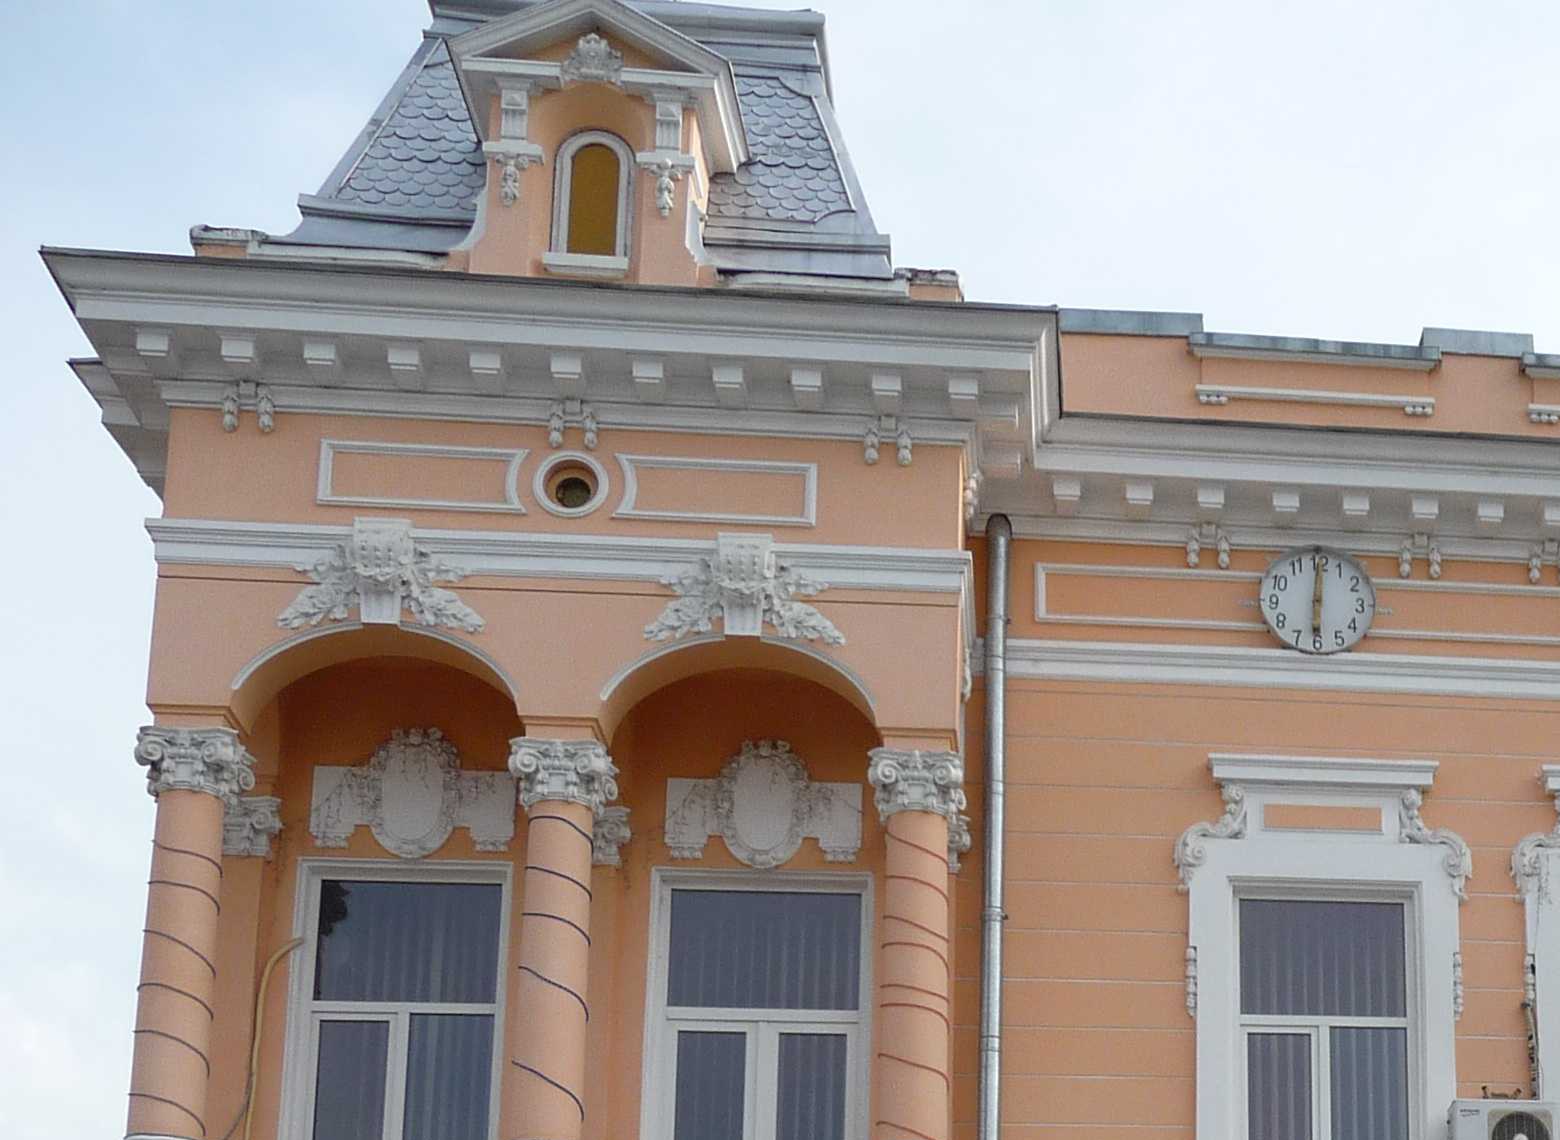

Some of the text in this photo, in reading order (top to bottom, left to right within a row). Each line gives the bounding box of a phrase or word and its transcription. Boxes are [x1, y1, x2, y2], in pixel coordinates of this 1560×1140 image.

[1289, 557, 1302, 576] 11
[1310, 556, 1328, 572] 12
[1336, 563, 1342, 579] 1
[1272, 574, 1287, 591] 10
[1350, 576, 1360, 592] 2
[1269, 594, 1279, 610] 9
[1355, 598, 1364, 614] 3
[1276, 613, 1286, 629] 8
[1347, 617, 1357, 633] 4
[1292, 630, 1302, 645] 7
[1313, 635, 1322, 650] 6
[1335, 630, 1345, 646] 5
